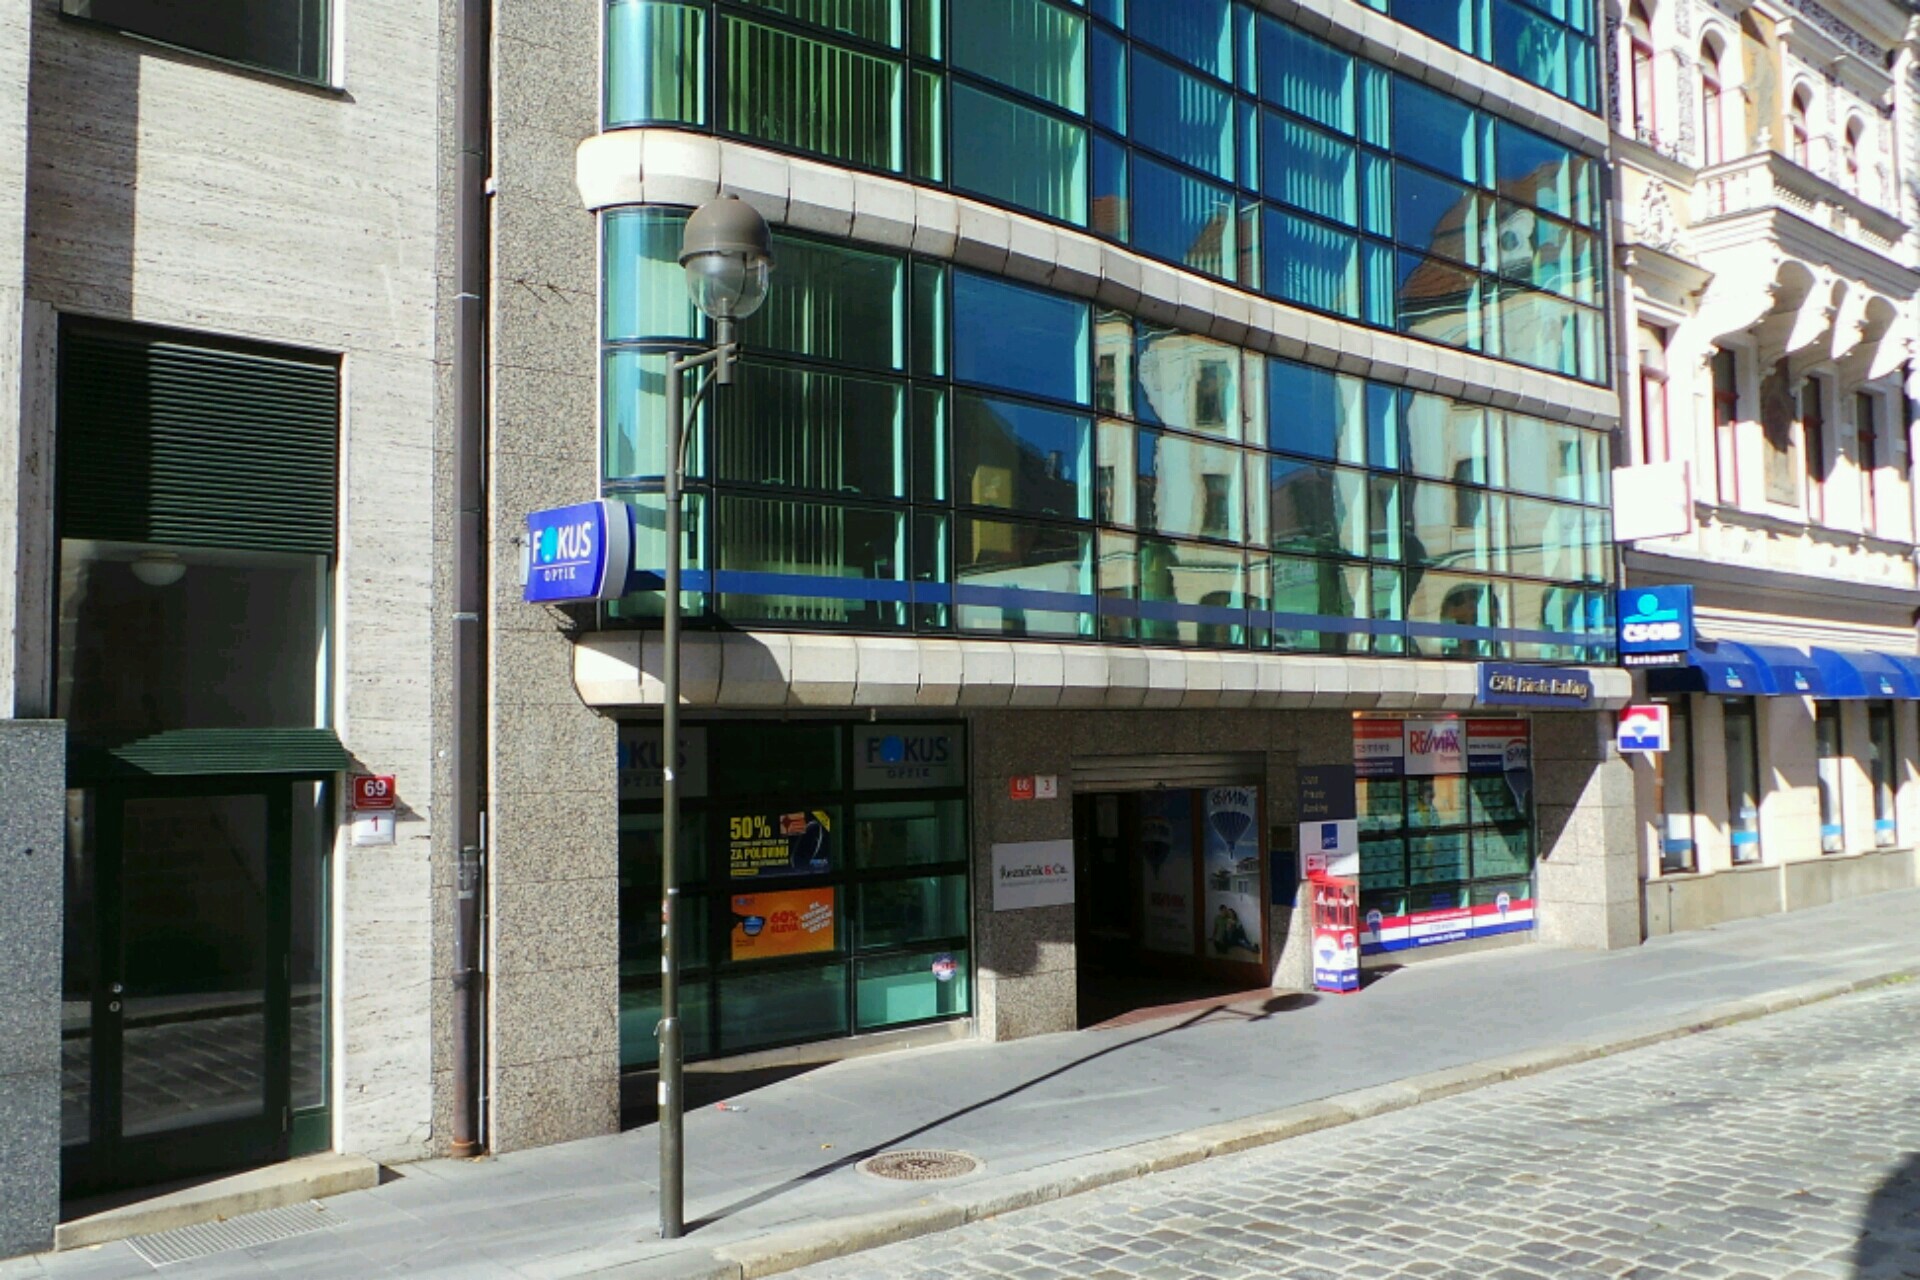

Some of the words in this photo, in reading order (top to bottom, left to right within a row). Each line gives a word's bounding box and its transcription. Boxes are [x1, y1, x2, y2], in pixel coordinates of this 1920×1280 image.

[532, 520, 593, 564] FOKUS
[543, 566, 576, 582] OPTIK
[865, 735, 948, 764] FOKUS
[363, 779, 387, 797] 69
[370, 815, 379, 832] 1
[729, 814, 772, 841] 50%
